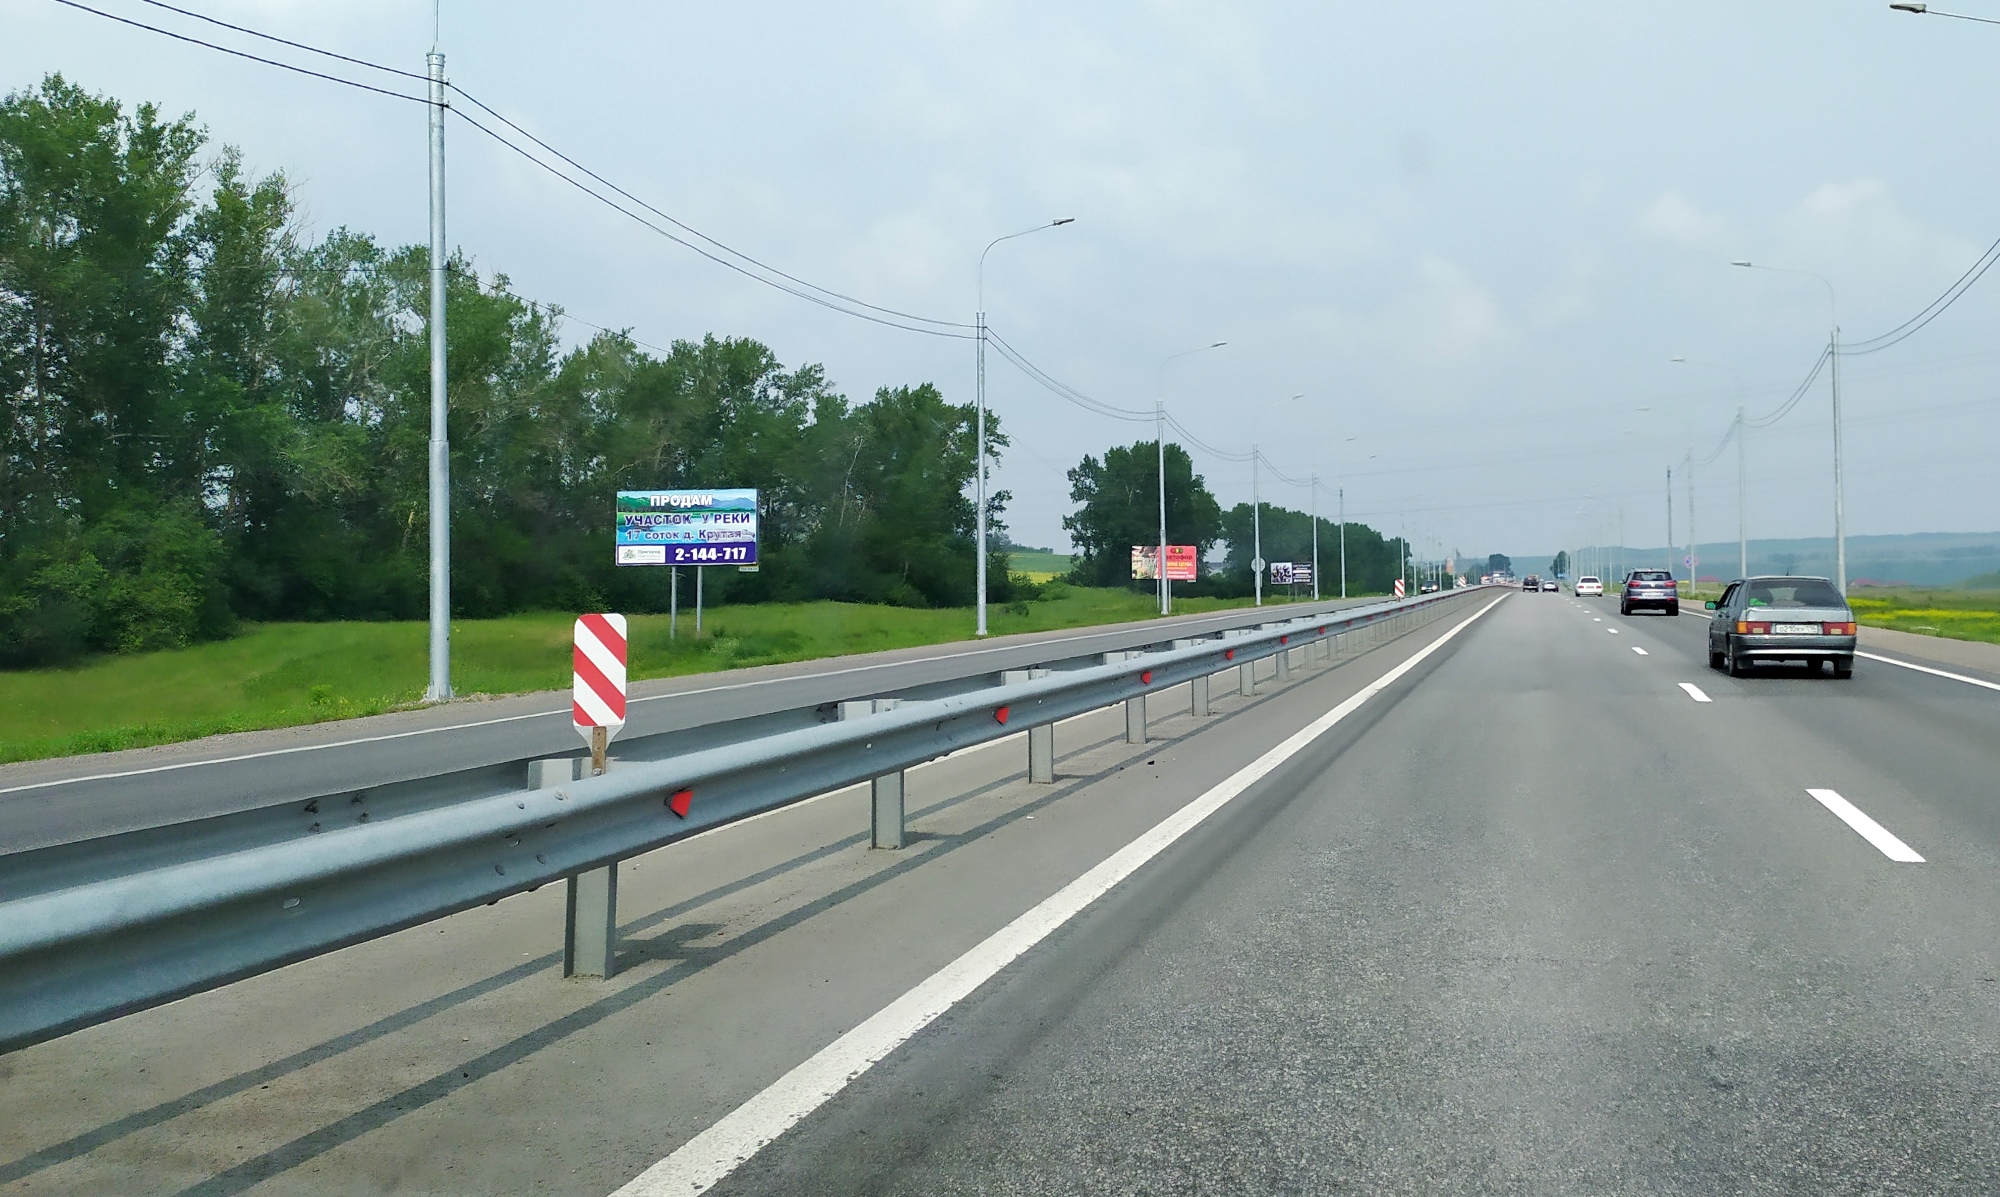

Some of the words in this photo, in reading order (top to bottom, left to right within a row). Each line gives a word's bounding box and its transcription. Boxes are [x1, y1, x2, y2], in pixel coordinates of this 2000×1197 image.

[650, 494, 713, 507] ПРОДАМ
[624, 514, 692, 526] УЧАСТОК
[714, 513, 750, 524] РЕКИ
[626, 531, 641, 540] 17
[645, 531, 680, 540] соток
[699, 529, 742, 541] Крутая
[675, 547, 747, 561] 2-144-717
